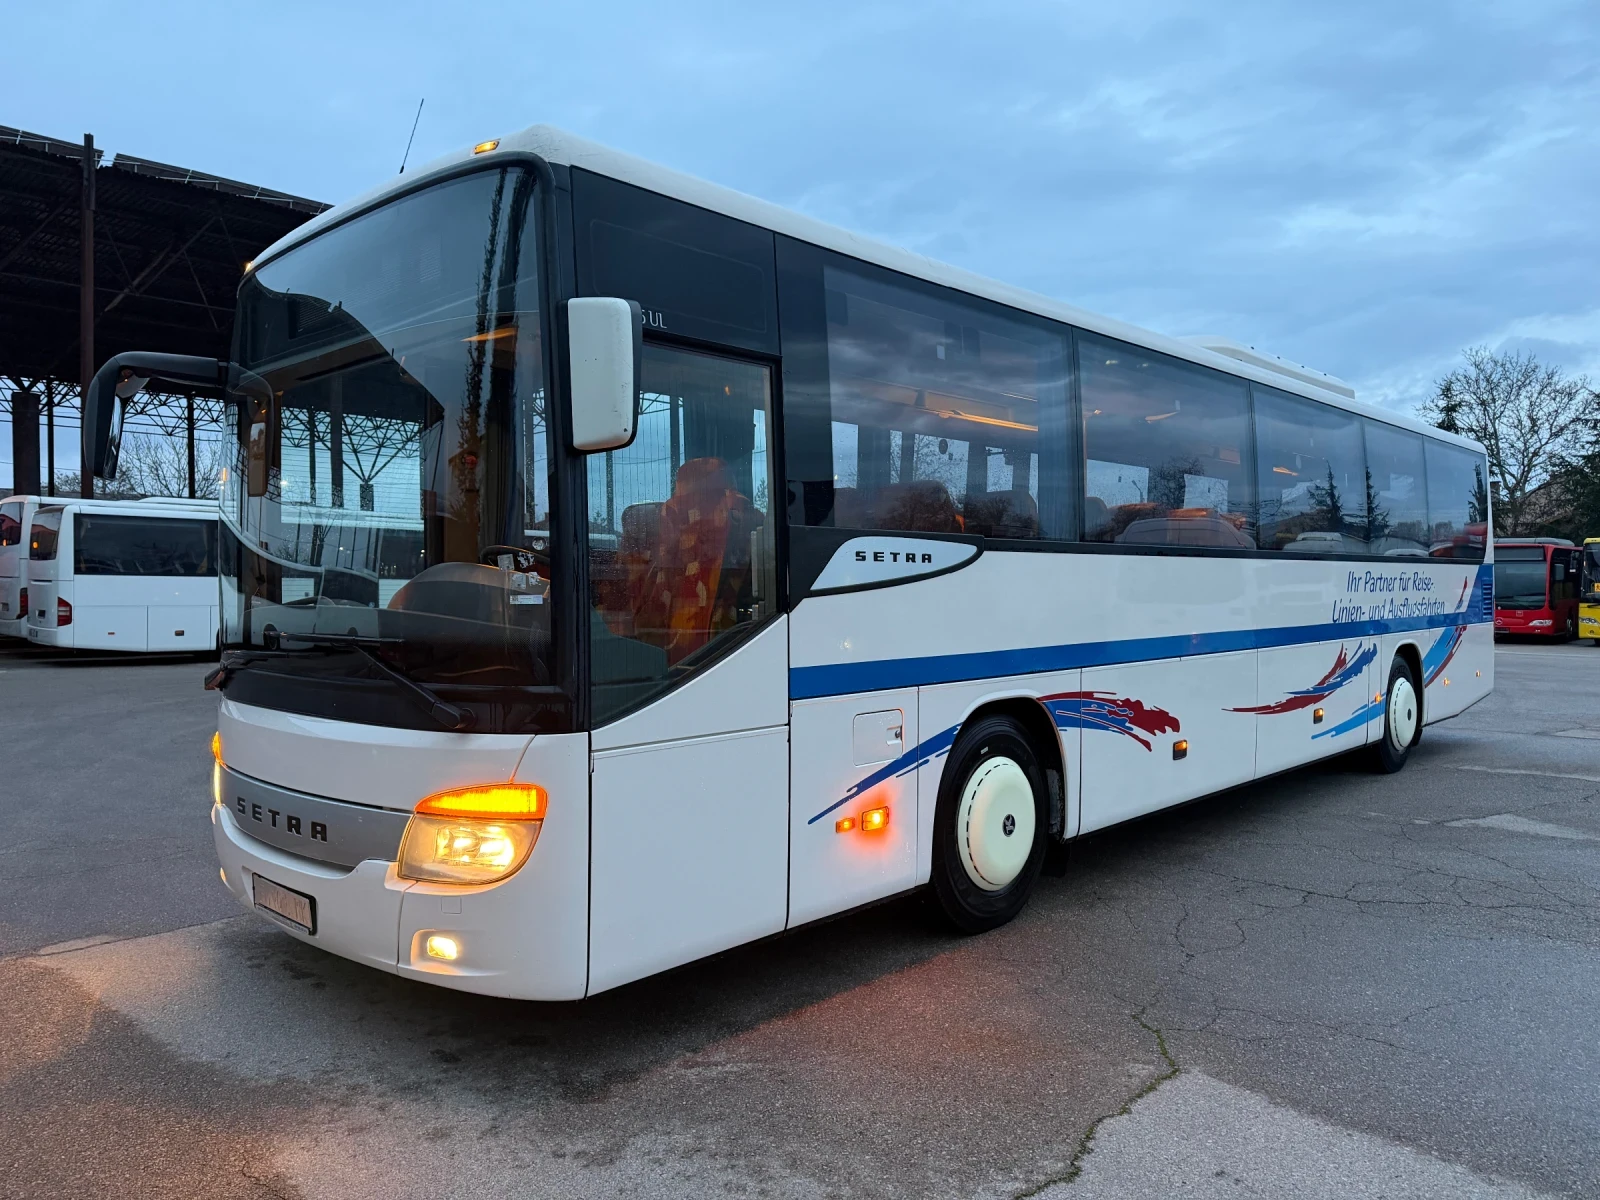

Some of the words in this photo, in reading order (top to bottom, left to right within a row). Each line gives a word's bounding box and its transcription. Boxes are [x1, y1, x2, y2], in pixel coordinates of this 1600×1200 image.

[855, 550, 932, 563] SETRA
[1346, 570, 1362, 593] Ihr
[1363, 570, 1398, 593] Partner
[1398, 571, 1412, 592] für
[1412, 571, 1434, 592] Reise-
[1332, 598, 1366, 623] Linien-
[1368, 598, 1386, 620] und
[1387, 596, 1446, 619] Ausflugsfahrten
[236, 796, 328, 843] SETRA
